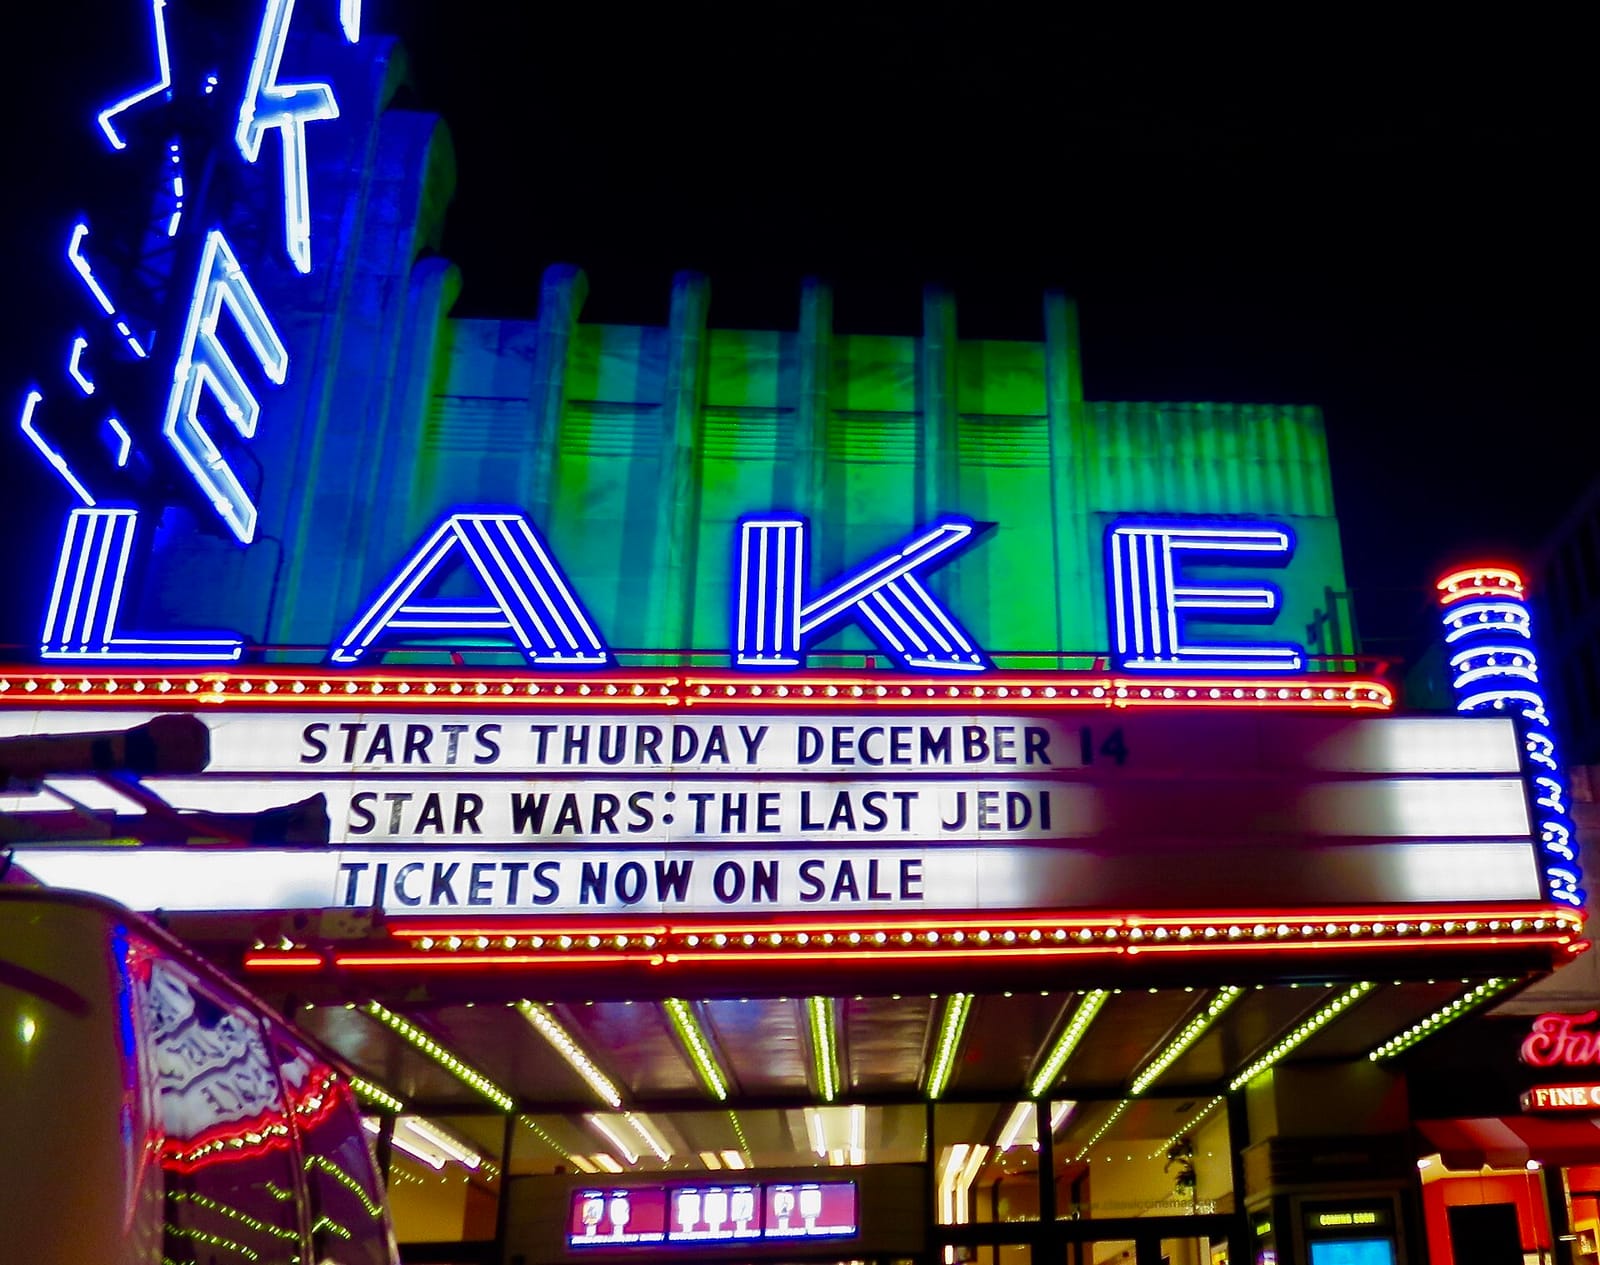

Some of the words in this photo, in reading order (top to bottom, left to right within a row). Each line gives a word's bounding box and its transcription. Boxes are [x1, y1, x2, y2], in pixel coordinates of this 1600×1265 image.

[37, 505, 1308, 673] LAKE
[300, 722, 502, 766] STARTS
[530, 723, 770, 766] THURDAY
[797, 724, 1052, 766] DECEMBER
[1079, 725, 1129, 768] 14
[348, 791, 485, 835] STAR
[799, 790, 919, 833] LAST
[940, 790, 1052, 832] JEDI
[339, 860, 561, 908] TICKETS
[579, 859, 695, 906] NOW
[712, 859, 780, 905] ON
[798, 858, 925, 903] SALE
[1535, 1087, 1588, 1107] FINE
